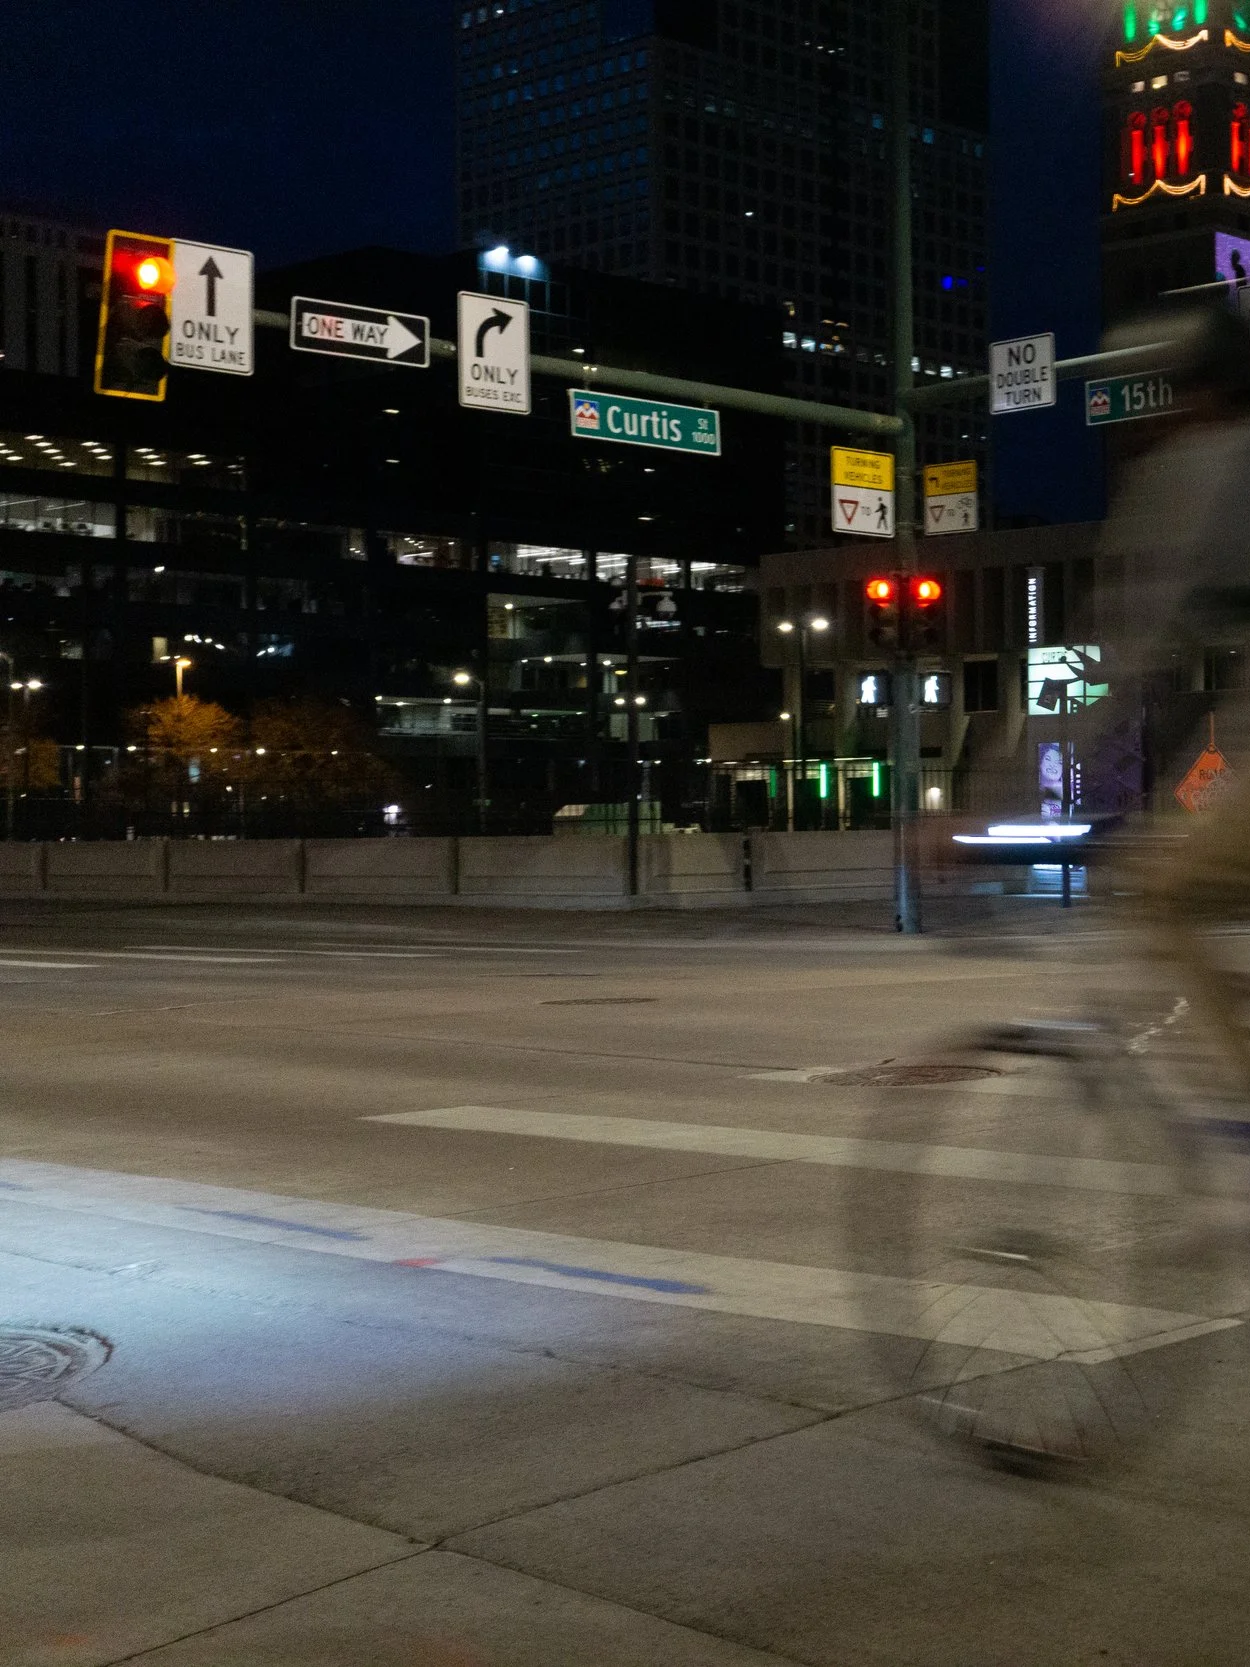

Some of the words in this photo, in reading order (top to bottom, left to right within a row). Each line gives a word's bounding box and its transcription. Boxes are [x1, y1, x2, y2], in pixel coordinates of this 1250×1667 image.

[182, 319, 240, 346] ONLY
[307, 316, 345, 339] ONE
[352, 323, 389, 345] WAY
[176, 342, 205, 360] BUS
[211, 346, 246, 366] LANE
[1008, 343, 1037, 367] NO
[471, 363, 519, 386] ONLY
[997, 366, 1048, 390] DOUBLE
[466, 385, 499, 401] BUSES
[1005, 387, 1042, 407] TURN
[1120, 377, 1173, 412] 15th
[606, 405, 682, 443] Curtis
[845, 456, 881, 470] TURNING
[843, 471, 884, 485] VEHICLES
[1028, 577, 1037, 643] INFORMATION
